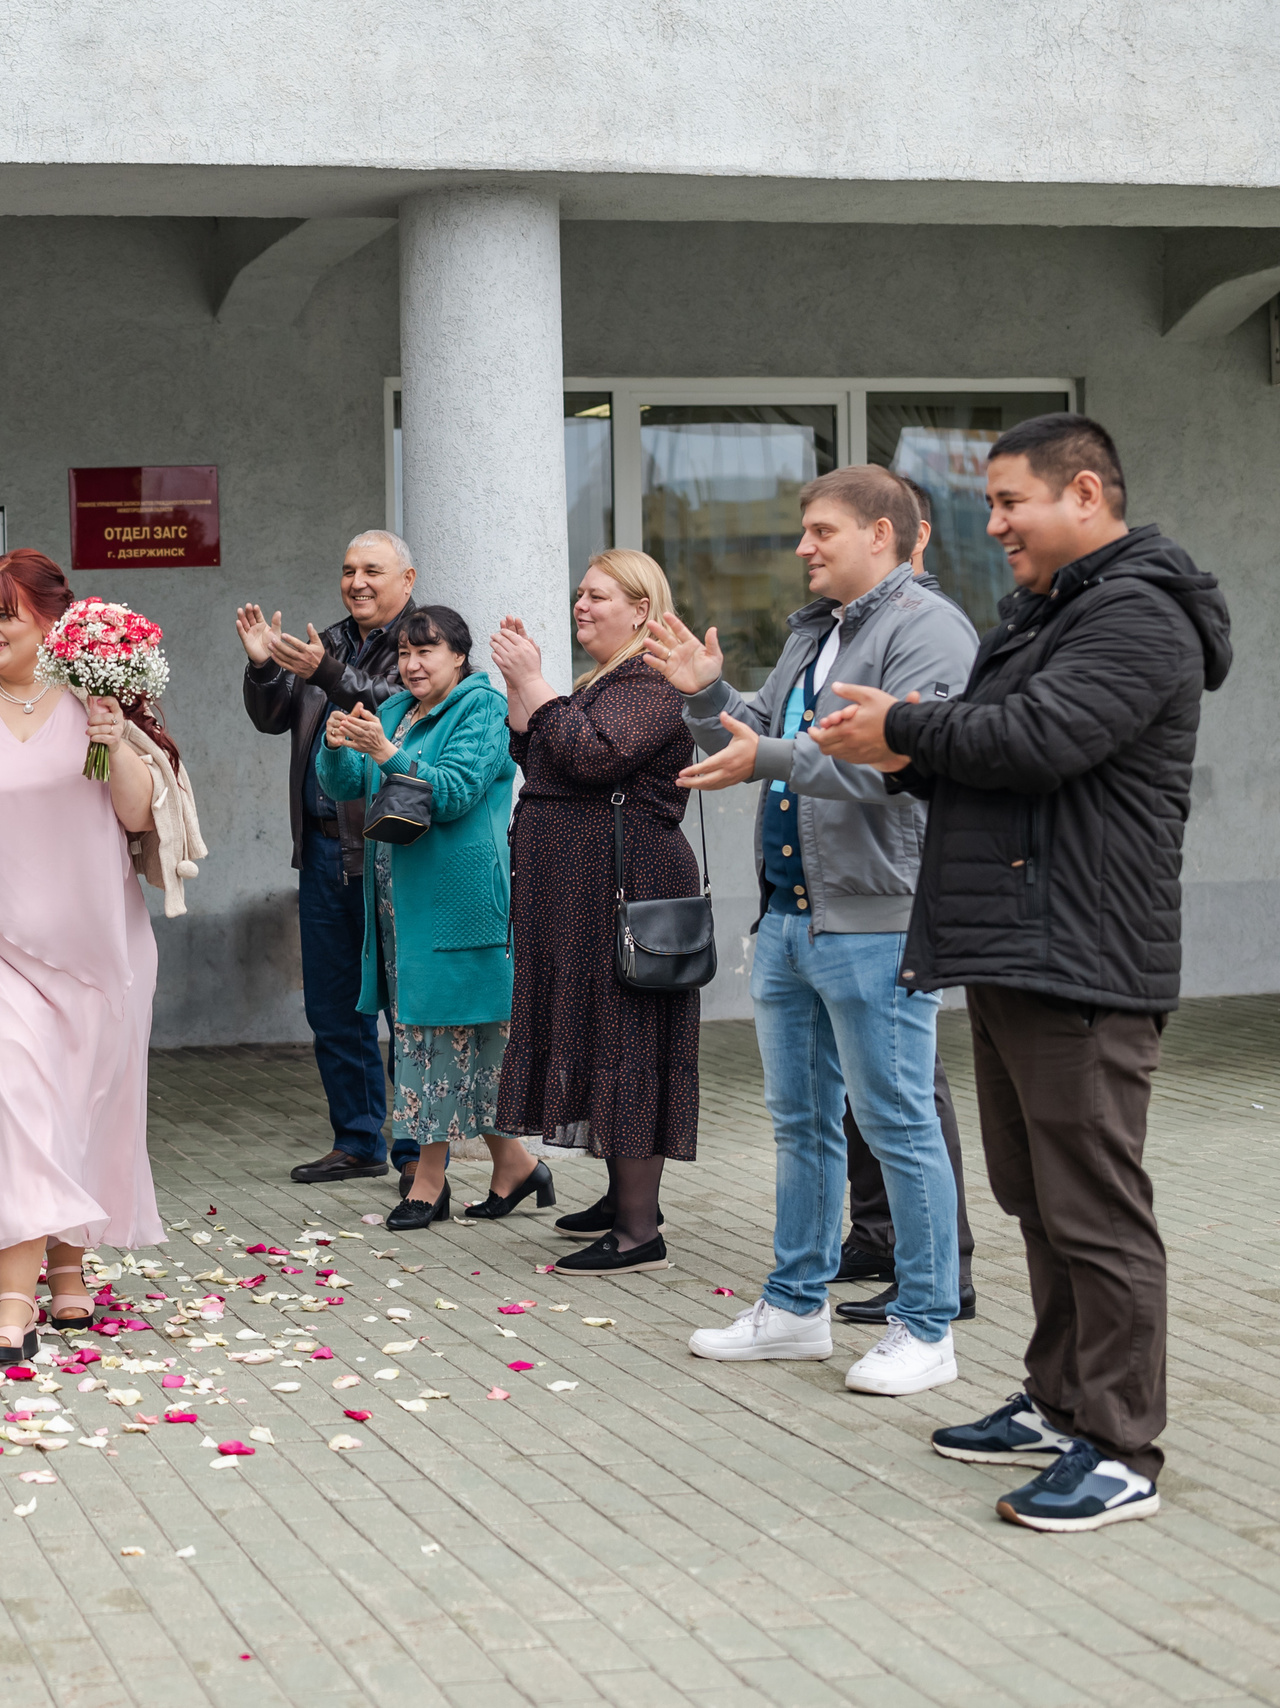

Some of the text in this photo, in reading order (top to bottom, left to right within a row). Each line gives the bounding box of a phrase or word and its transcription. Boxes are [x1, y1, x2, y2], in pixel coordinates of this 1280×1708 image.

[104, 526, 188, 542] ОТДЕЛ ЗАГС
[117, 548, 185, 559] ДЗЕРЖИНСК
